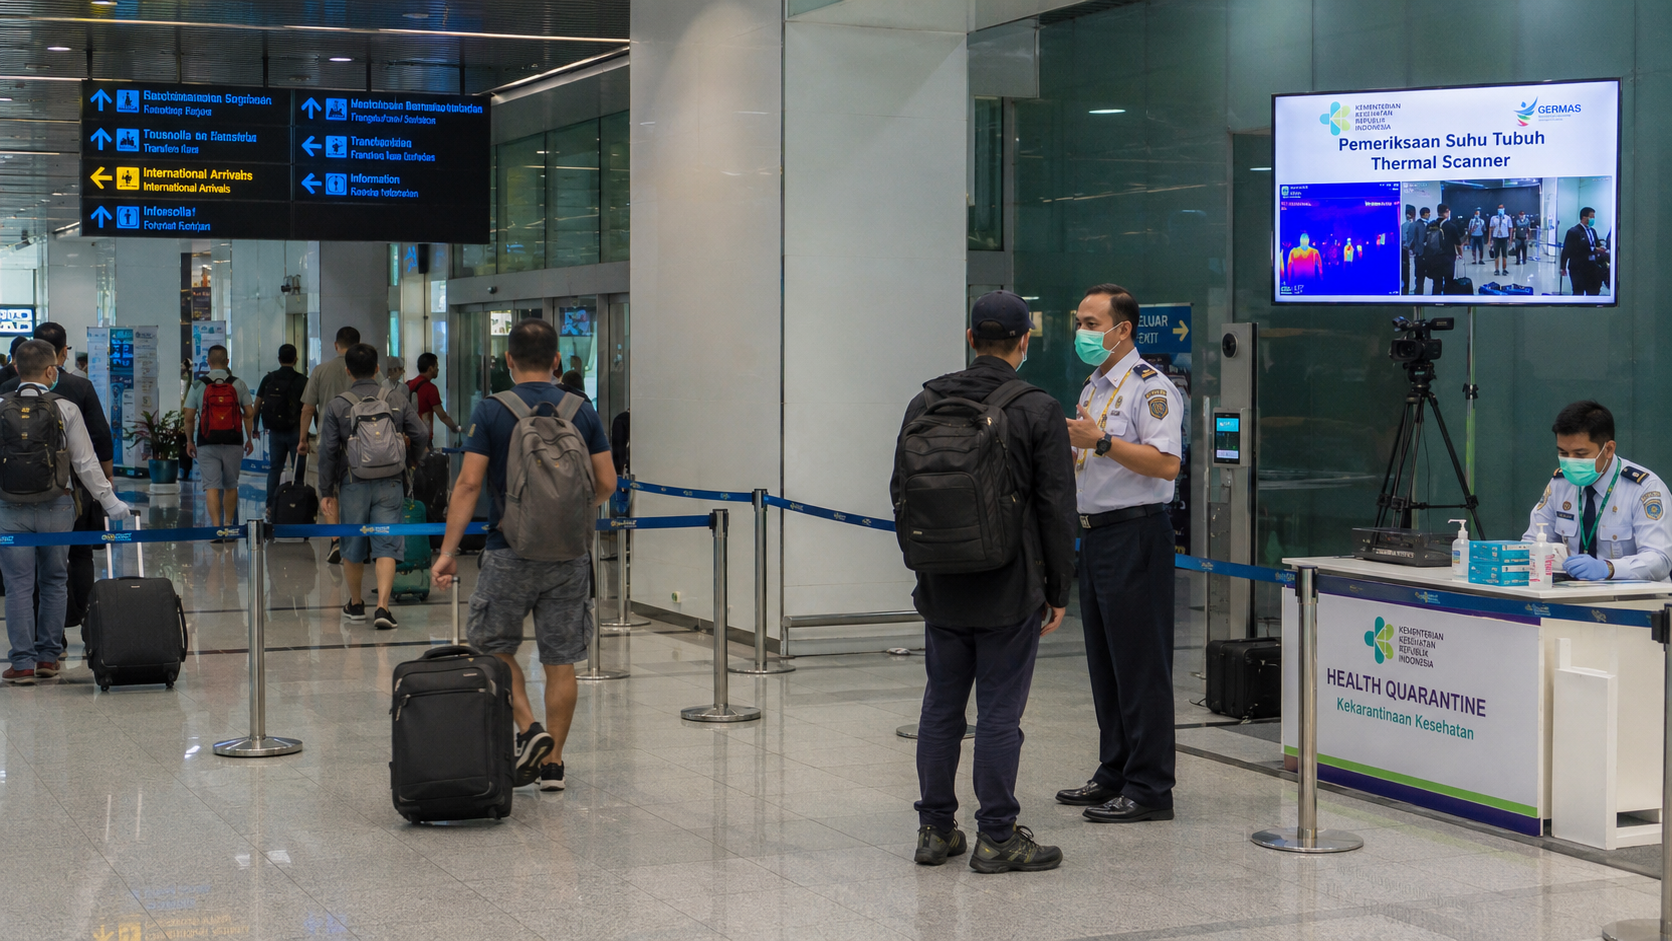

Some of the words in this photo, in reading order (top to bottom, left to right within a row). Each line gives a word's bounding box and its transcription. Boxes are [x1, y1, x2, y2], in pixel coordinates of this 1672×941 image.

[1537, 103, 1582, 115] GERMAS
[1339, 135, 1440, 152] Pemeriksaan
[1445, 133, 1487, 148] Suhu
[1494, 130, 1545, 146] Tubuh
[1371, 155, 1437, 171] Thermal
[1443, 154, 1511, 169] Scanner
[143, 167, 208, 180] International
[350, 172, 401, 185] Information
[143, 181, 198, 193] International
[199, 183, 231, 194] Arrivals
[1138, 315, 1169, 328] ELUAR
[1327, 667, 1382, 695] HEALTH
[1385, 680, 1487, 718] QUARANTINE
[1336, 697, 1412, 726] Kekarantinaan
[1415, 714, 1474, 740] Kesehatan
